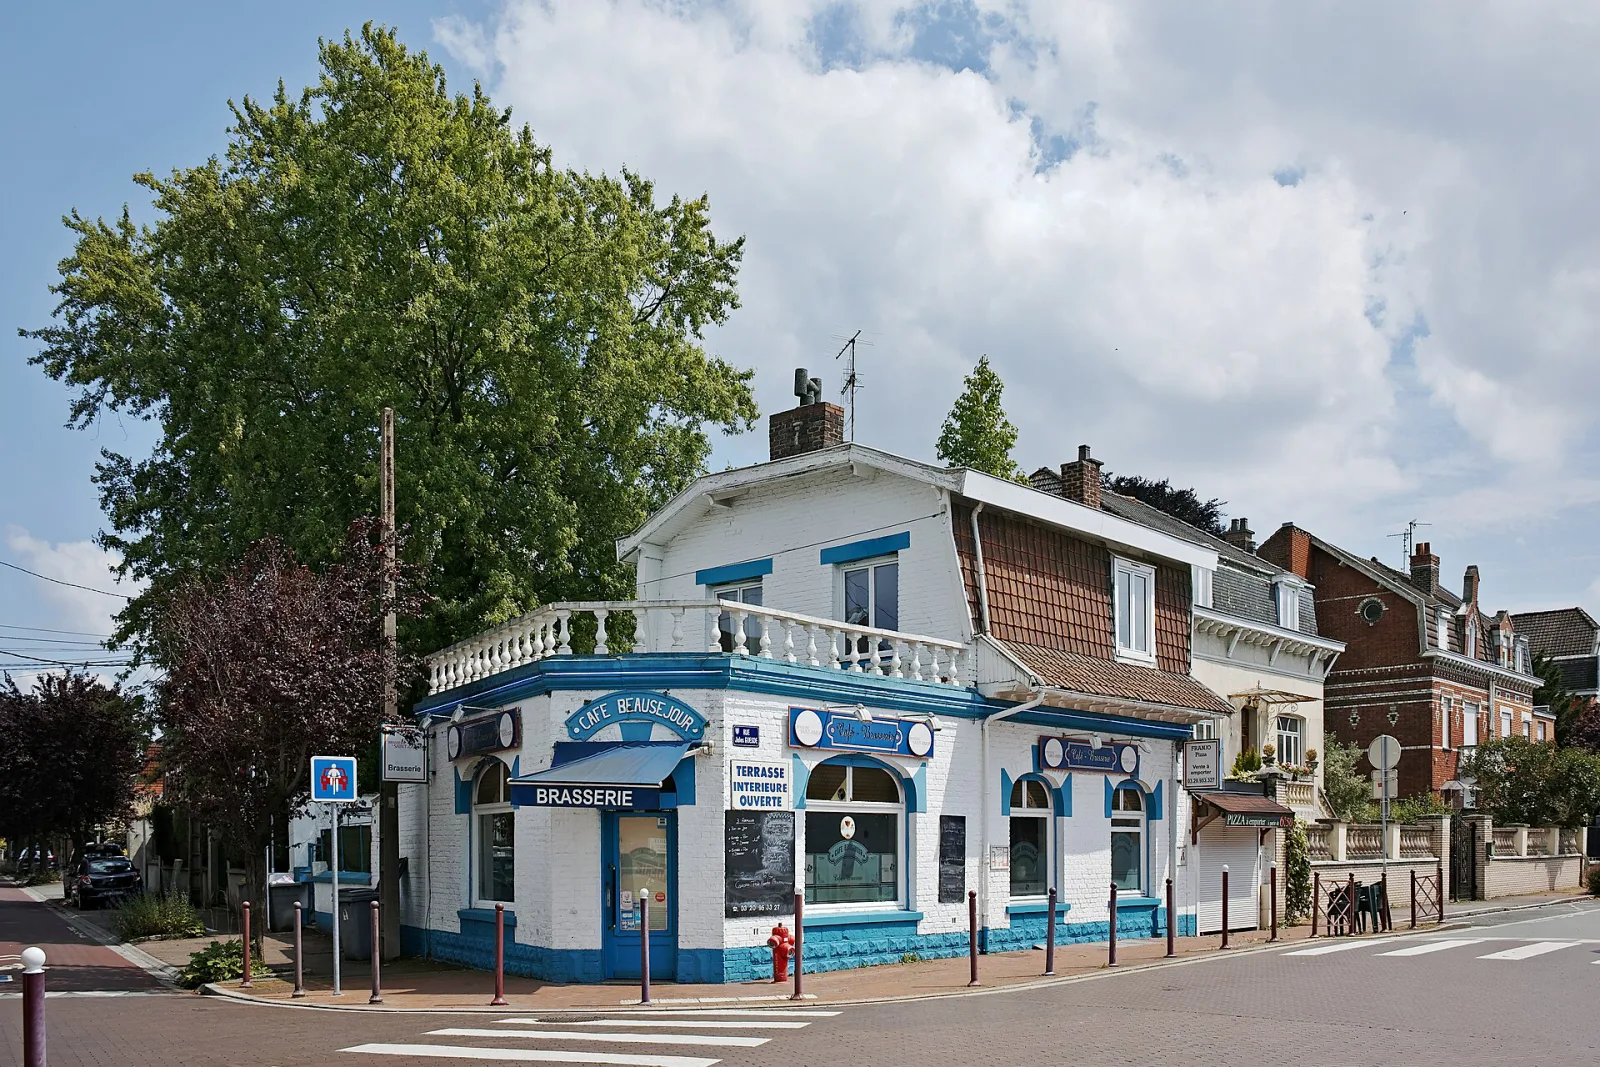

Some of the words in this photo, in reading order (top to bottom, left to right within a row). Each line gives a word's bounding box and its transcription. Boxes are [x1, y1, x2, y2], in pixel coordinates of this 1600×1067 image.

[579, 703, 611, 729] CAFE
[617, 697, 694, 732] BEAUSEJOUR
[388, 764, 421, 772] Brasserie
[736, 765, 785, 779] TERRASSE
[733, 781, 788, 793] INTERIEURE
[536, 788, 633, 806] BRASSERIE
[739, 794, 782, 807] OUVERTE
[1226, 814, 1245, 825] PIZZA
